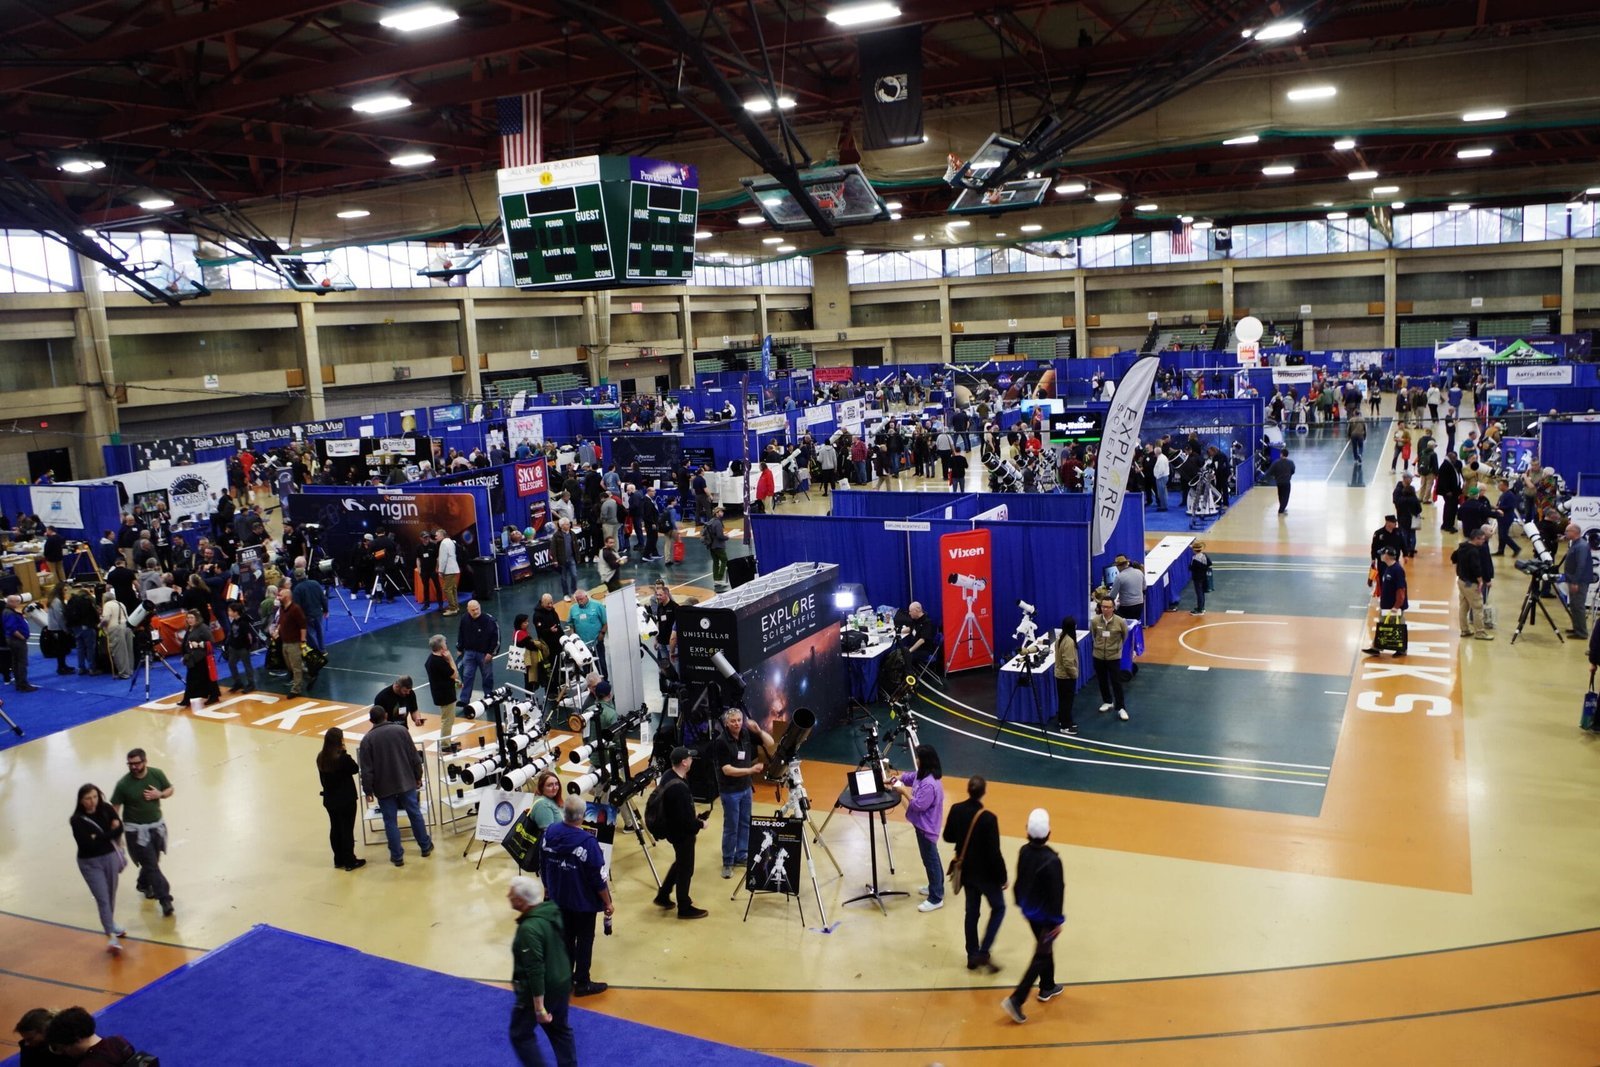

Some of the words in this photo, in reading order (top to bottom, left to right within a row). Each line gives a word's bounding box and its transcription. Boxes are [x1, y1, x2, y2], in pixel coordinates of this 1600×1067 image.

[575, 209, 600, 222] GUEST
[634, 209, 649, 219] HOME
[679, 213, 694, 223] GUEST
[510, 218, 532, 229] HOME
[545, 219, 564, 228] PERIOD
[542, 249, 561, 257] PLAYER
[563, 247, 576, 255] FOUL
[590, 244, 608, 252] FOULS
[512, 252, 528, 260] FOULS
[594, 270, 612, 278] SCORE
[516, 277, 532, 285] SCORE
[306, 423, 324, 433] Tele
[326, 421, 344, 430] Vue
[250, 430, 270, 440] Tele
[272, 428, 290, 438] Vue
[192, 438, 213, 448] Tele
[216, 435, 234, 445] Vue
[1101, 406, 1138, 522] EXPLORE
[518, 468, 535, 482] SKY
[536, 466, 542, 478] &
[520, 480, 544, 492] TELESCOPE
[534, 549, 550, 566] SKY
[948, 547, 984, 560] Vixen
[762, 594, 816, 632] EXPLORE
[762, 610, 816, 643] SCIENTIFIC
[682, 632, 730, 640] UNISTELLAR
[690, 646, 724, 654] EXPLORE
